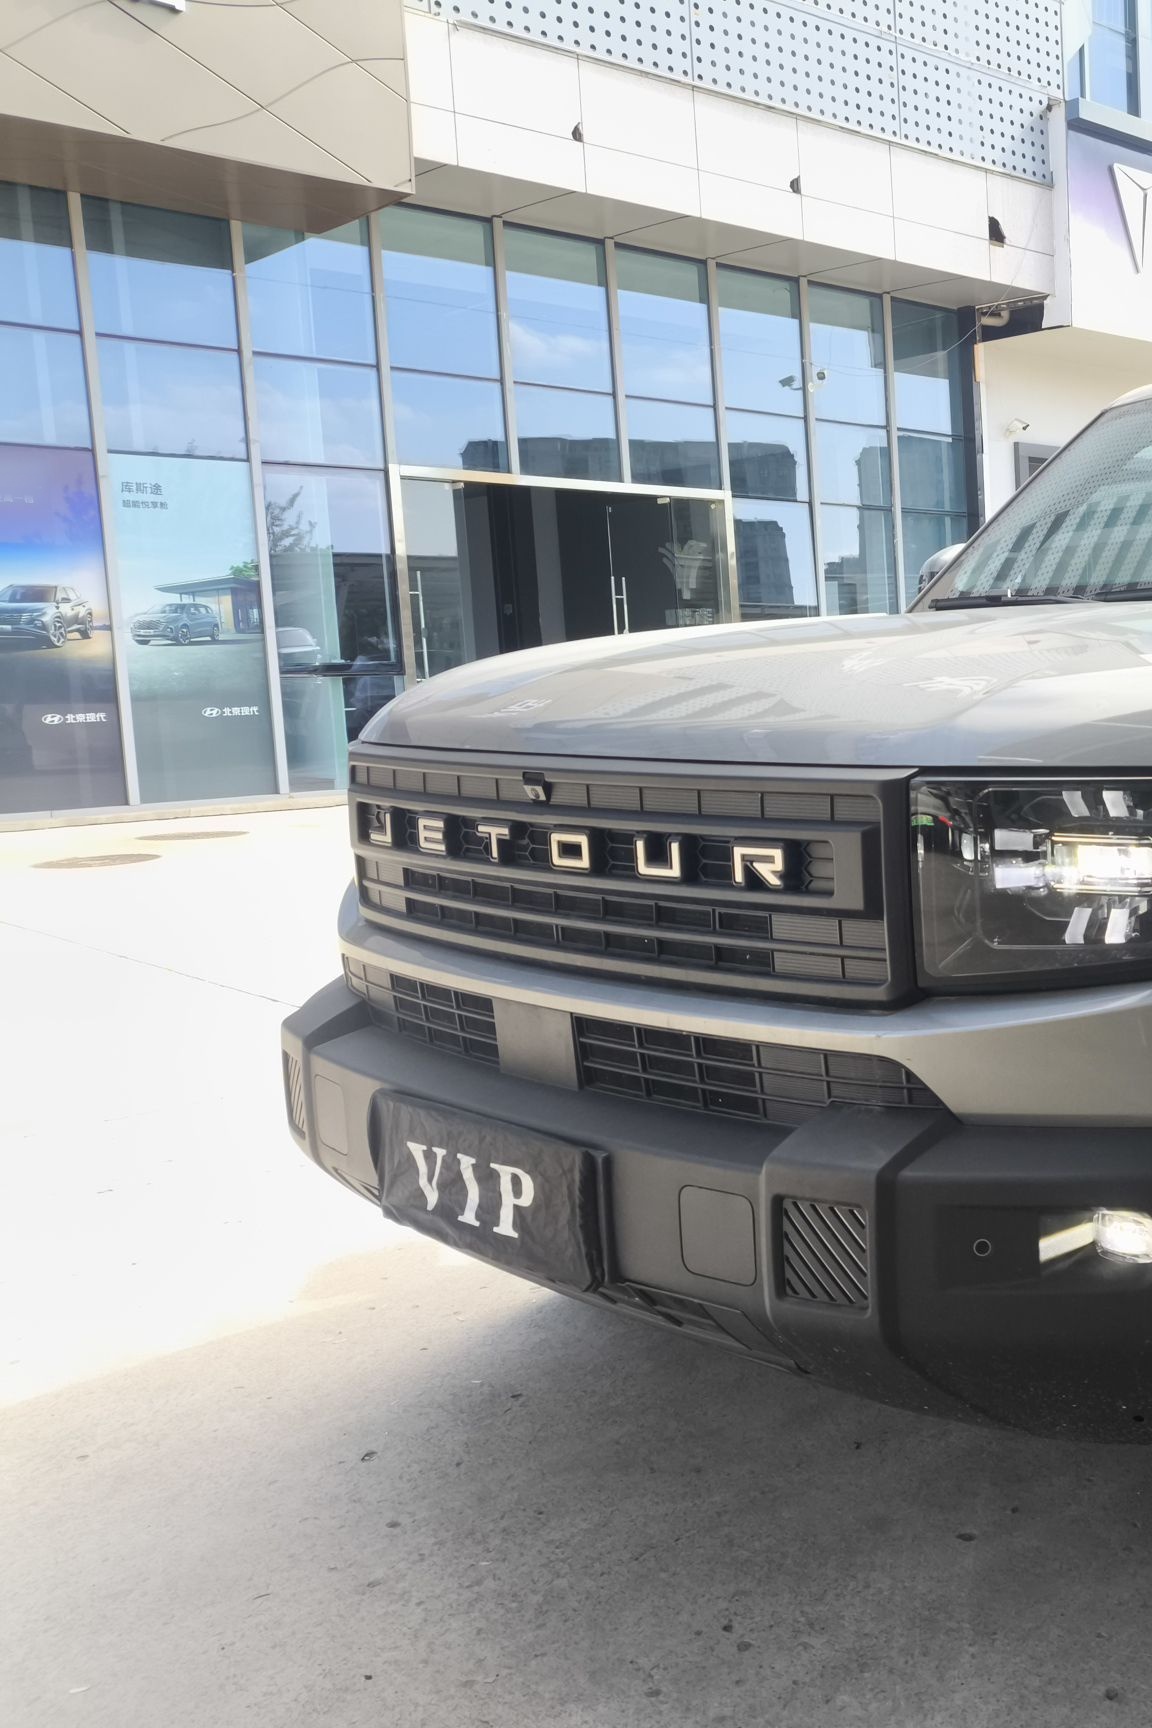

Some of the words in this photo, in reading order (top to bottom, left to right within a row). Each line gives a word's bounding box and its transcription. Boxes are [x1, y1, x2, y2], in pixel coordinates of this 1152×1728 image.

[121, 481, 163, 496] 库斯途
[65, 712, 108, 723] 北京现代
[222, 706, 260, 717] 北京现代
[367, 807, 788, 889] JETOUR
[406, 1140, 535, 1239] VIP
